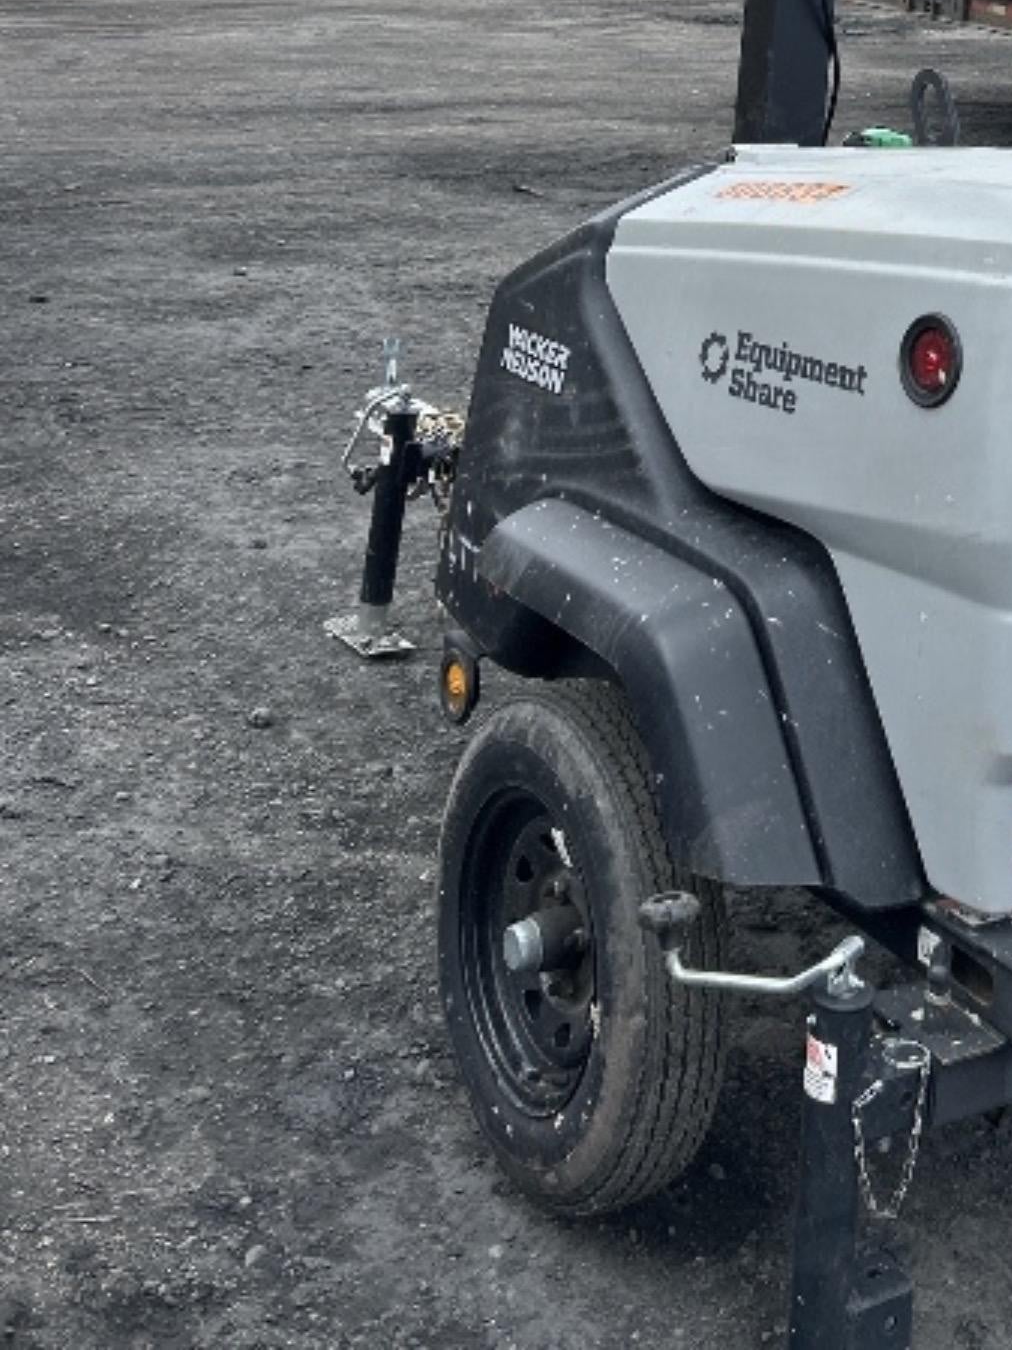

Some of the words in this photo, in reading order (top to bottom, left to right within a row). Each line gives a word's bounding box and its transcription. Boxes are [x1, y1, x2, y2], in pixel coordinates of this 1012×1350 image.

[508, 323, 571, 369] WACKER
[734, 329, 868, 396] Equipment
[500, 347, 565, 394] NEUSON
[728, 368, 797, 414] Share
